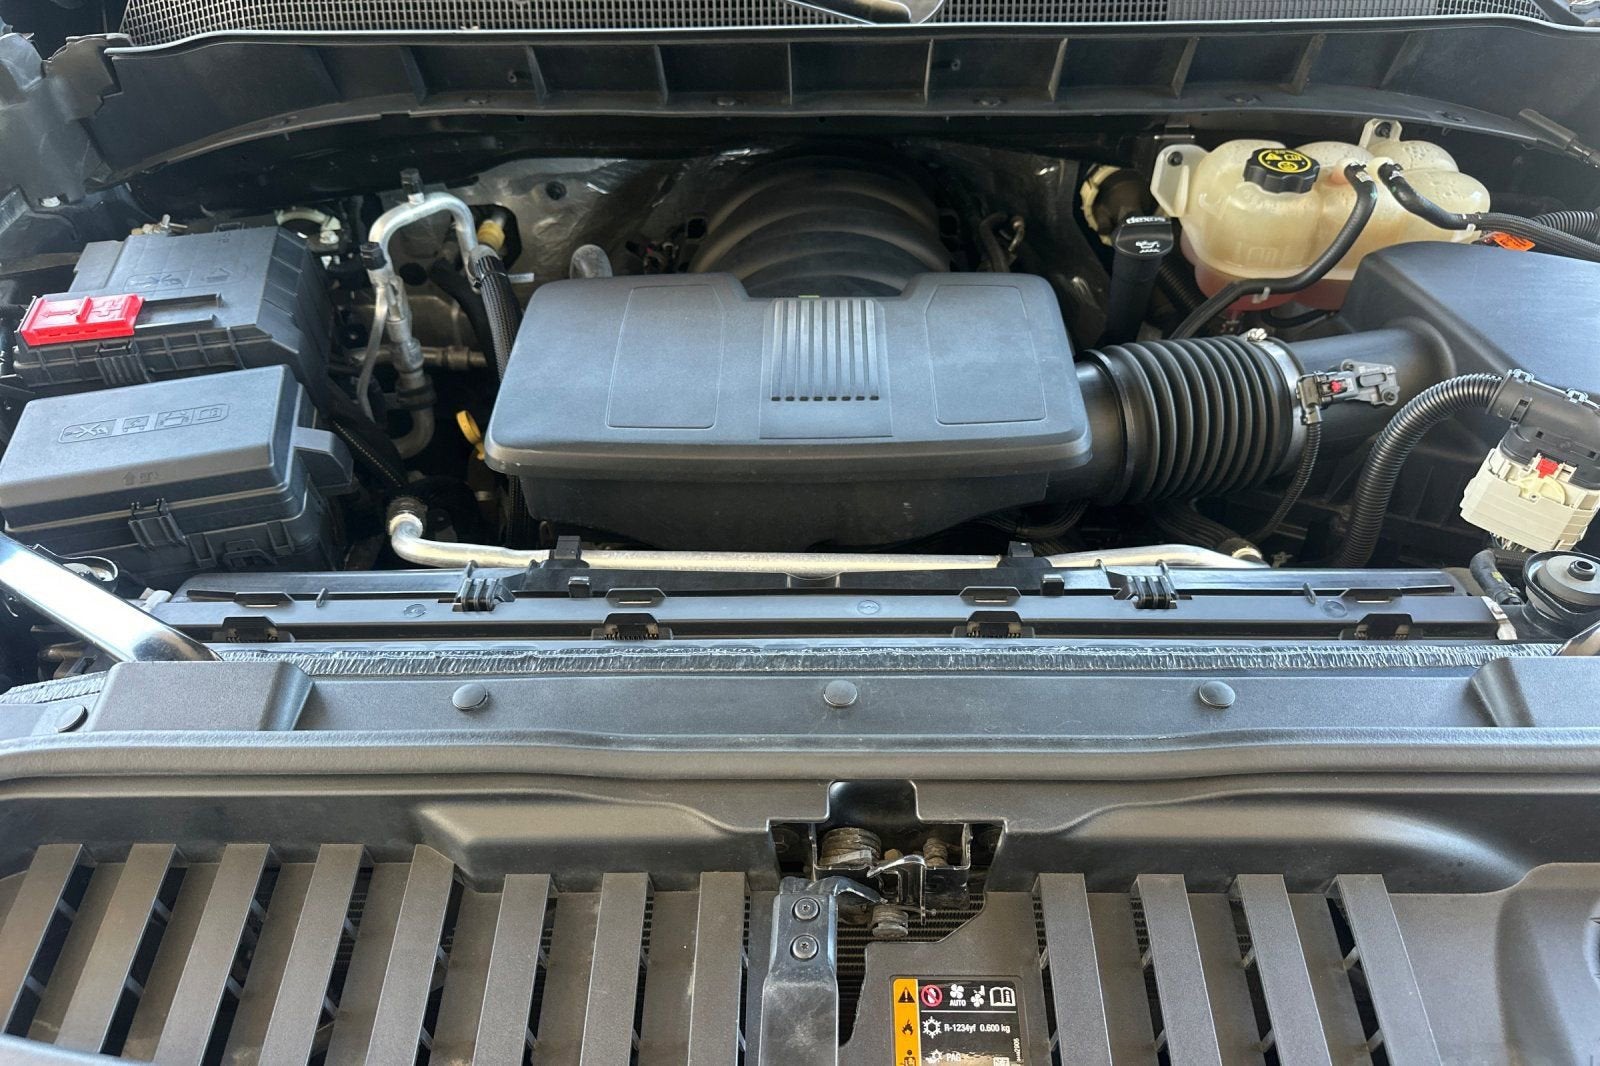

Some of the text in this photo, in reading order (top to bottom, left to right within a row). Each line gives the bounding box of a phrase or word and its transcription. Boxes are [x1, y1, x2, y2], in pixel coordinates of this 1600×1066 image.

[944, 1023, 1010, 1033] R-1234yf 0.600 kg
